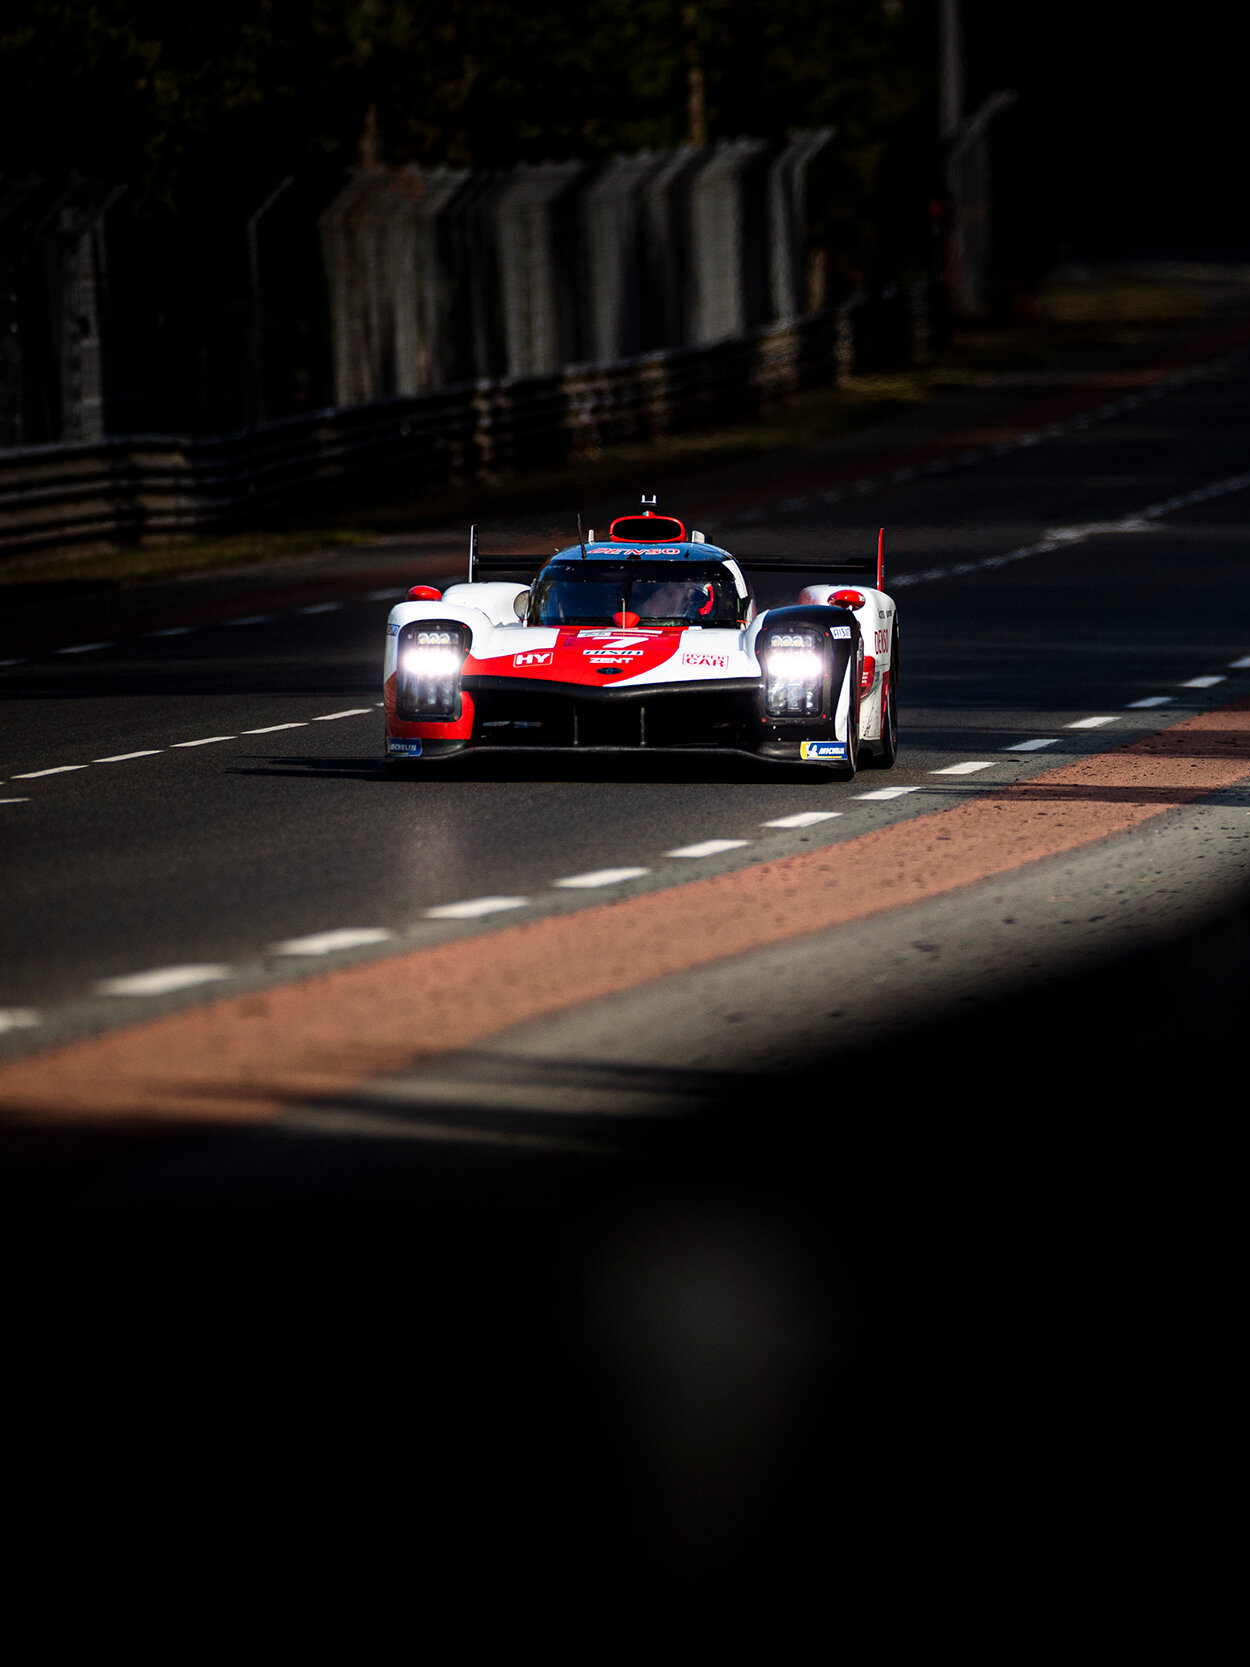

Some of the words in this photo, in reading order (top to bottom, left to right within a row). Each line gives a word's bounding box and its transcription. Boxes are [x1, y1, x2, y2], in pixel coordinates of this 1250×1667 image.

[592, 636, 649, 648] 7
[516, 653, 551, 665] HY
[686, 659, 724, 667] CAR
